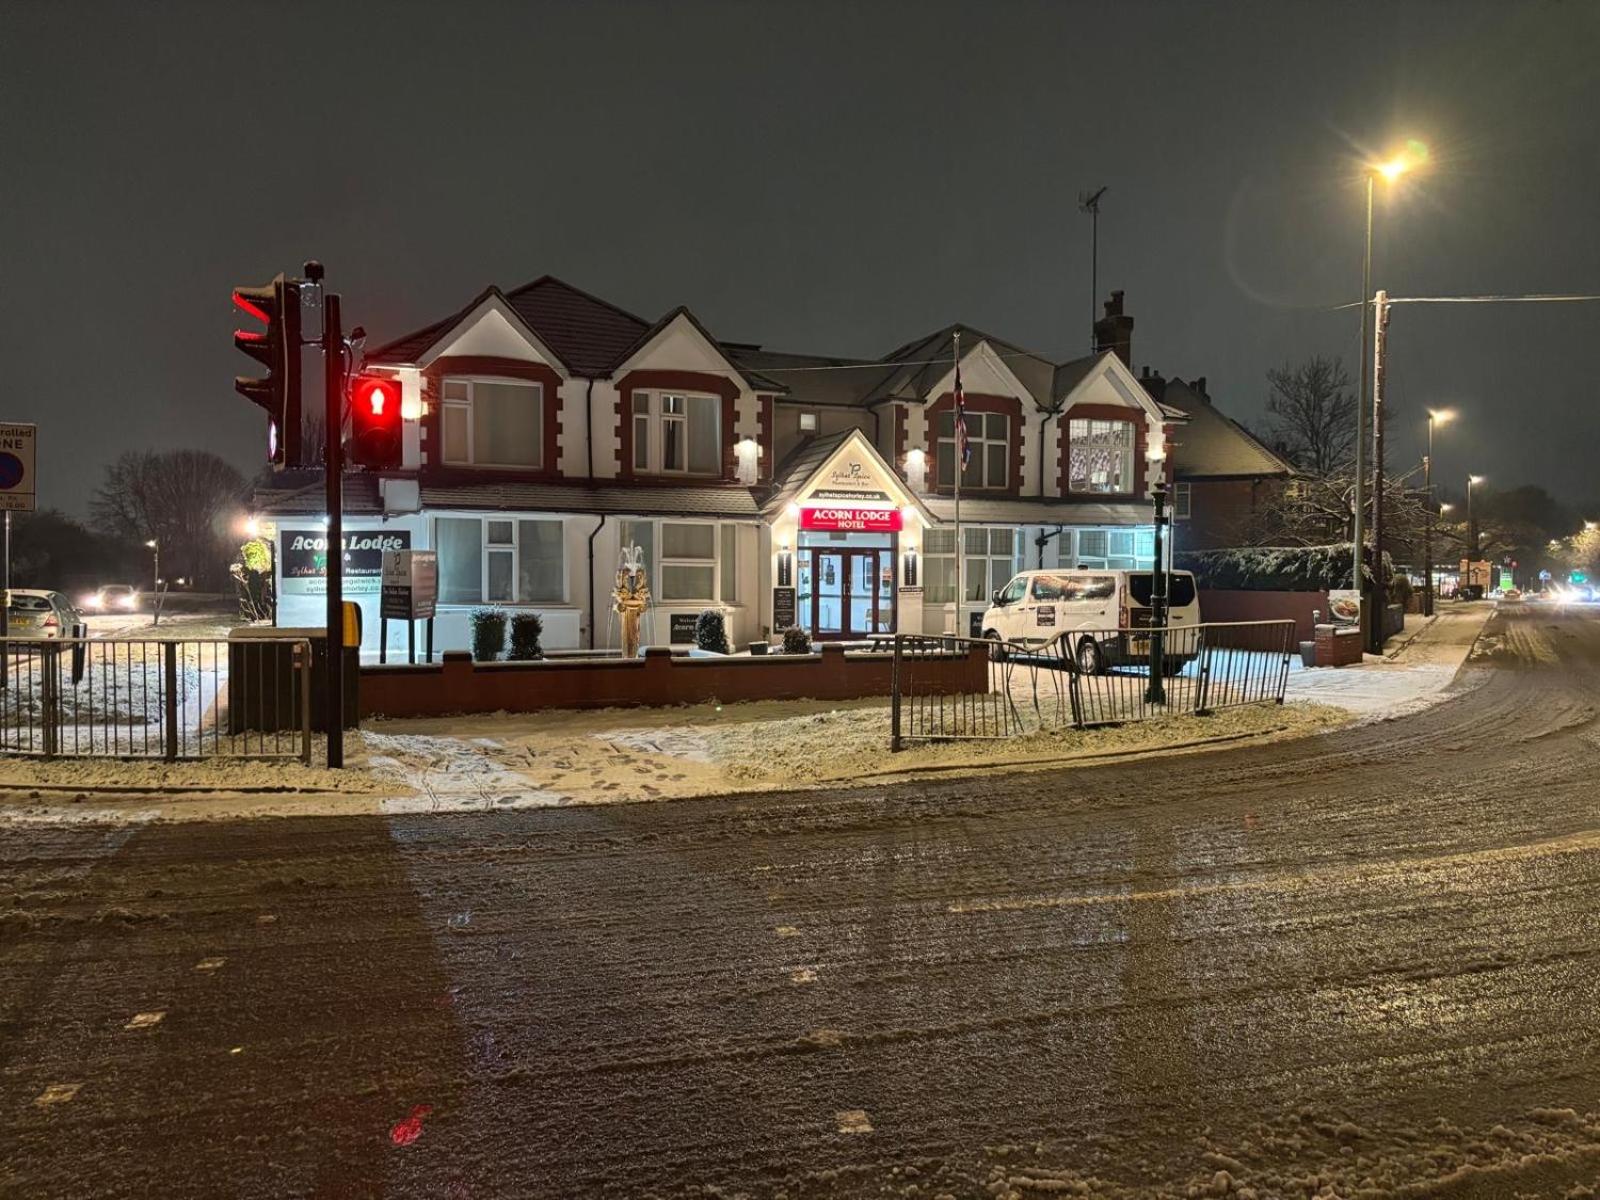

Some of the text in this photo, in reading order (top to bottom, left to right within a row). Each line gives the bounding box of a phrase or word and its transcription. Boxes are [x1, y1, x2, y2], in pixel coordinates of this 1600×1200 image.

[0, 438, 23, 449] NE
[813, 509, 891, 521] ACORN LODGE
[837, 520, 866, 529] HOTEL
[290, 535, 403, 552] Aco Lodge
